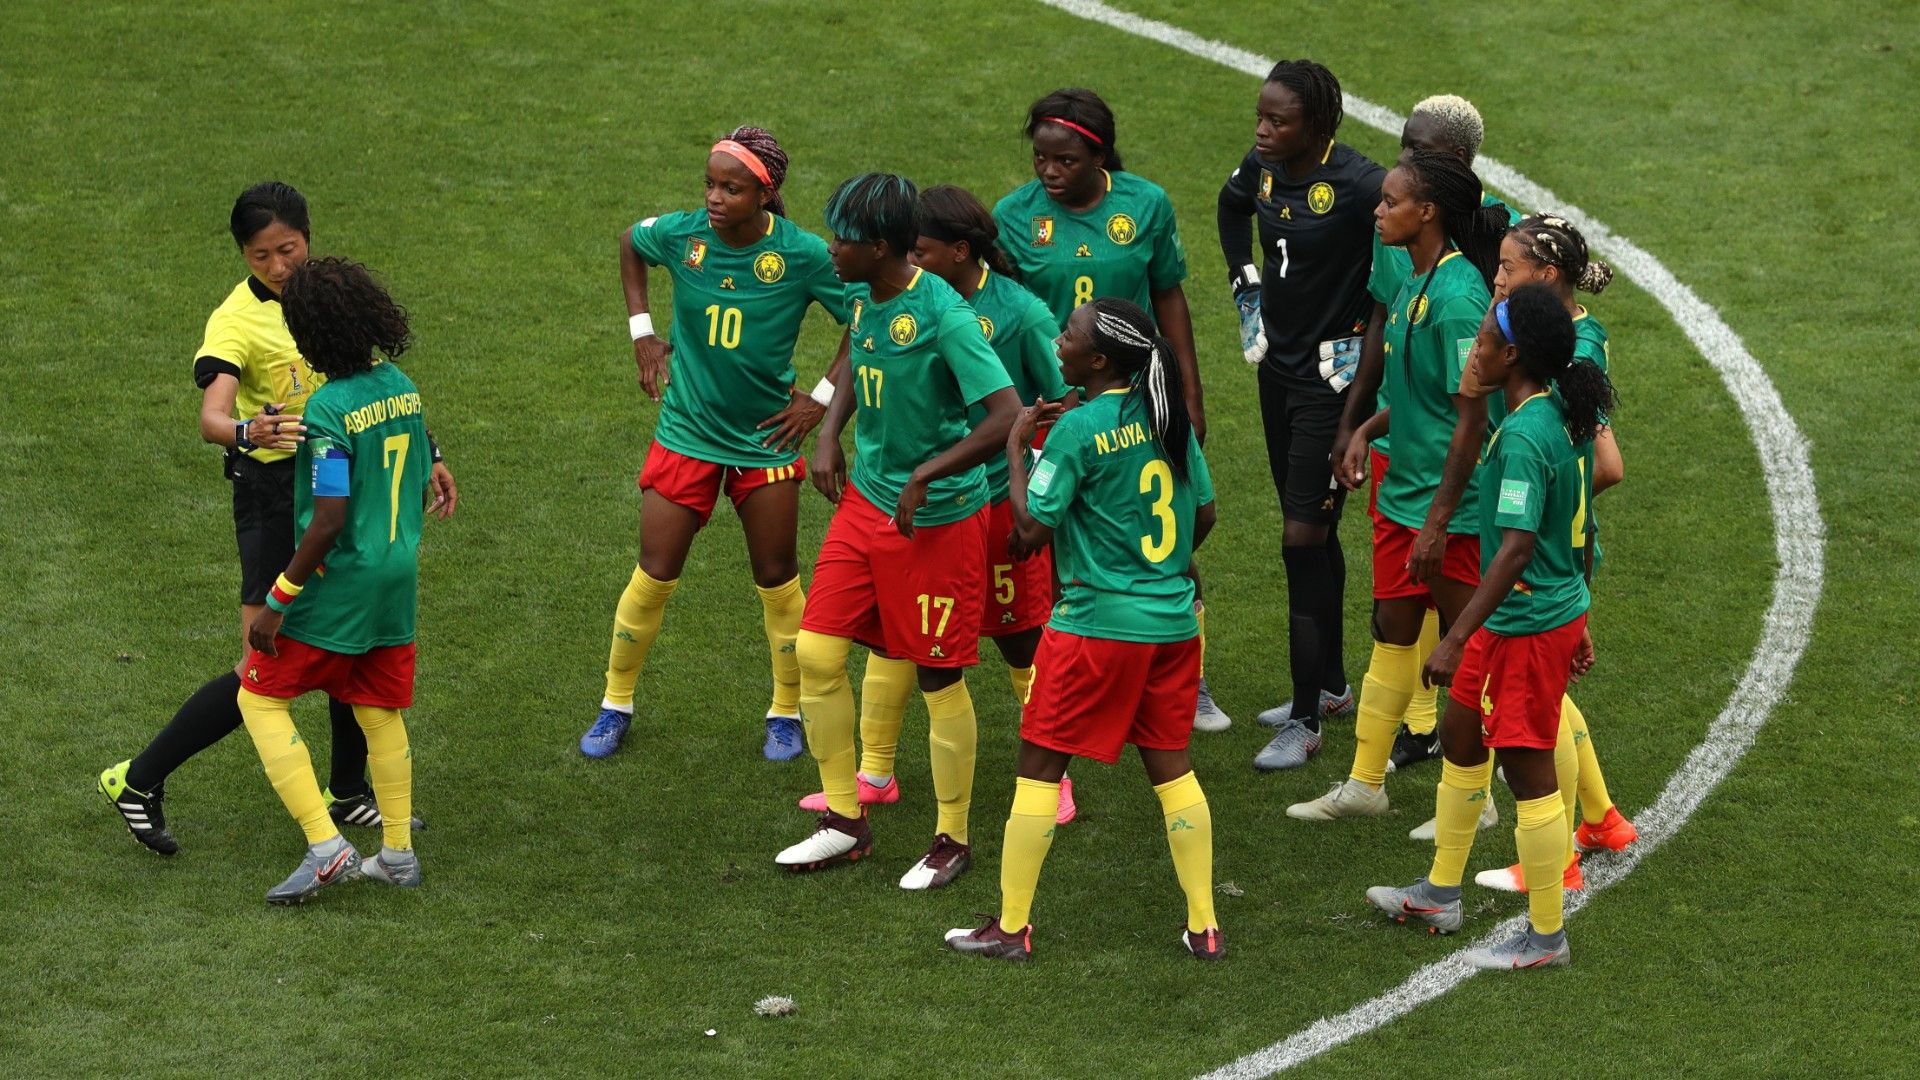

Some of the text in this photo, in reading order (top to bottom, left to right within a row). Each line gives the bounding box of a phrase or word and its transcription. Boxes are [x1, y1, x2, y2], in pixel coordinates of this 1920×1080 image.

[1276, 238, 1289, 278] 1
[1075, 275, 1093, 309] 8
[705, 304, 742, 349] 10
[858, 365, 883, 409] 17
[344, 400, 387, 435] ABOUDI
[383, 433, 410, 544] 7
[1139, 459, 1177, 563] 3
[994, 564, 1015, 604] 5
[917, 593, 955, 637] 17
[1480, 673, 1494, 716] 4
